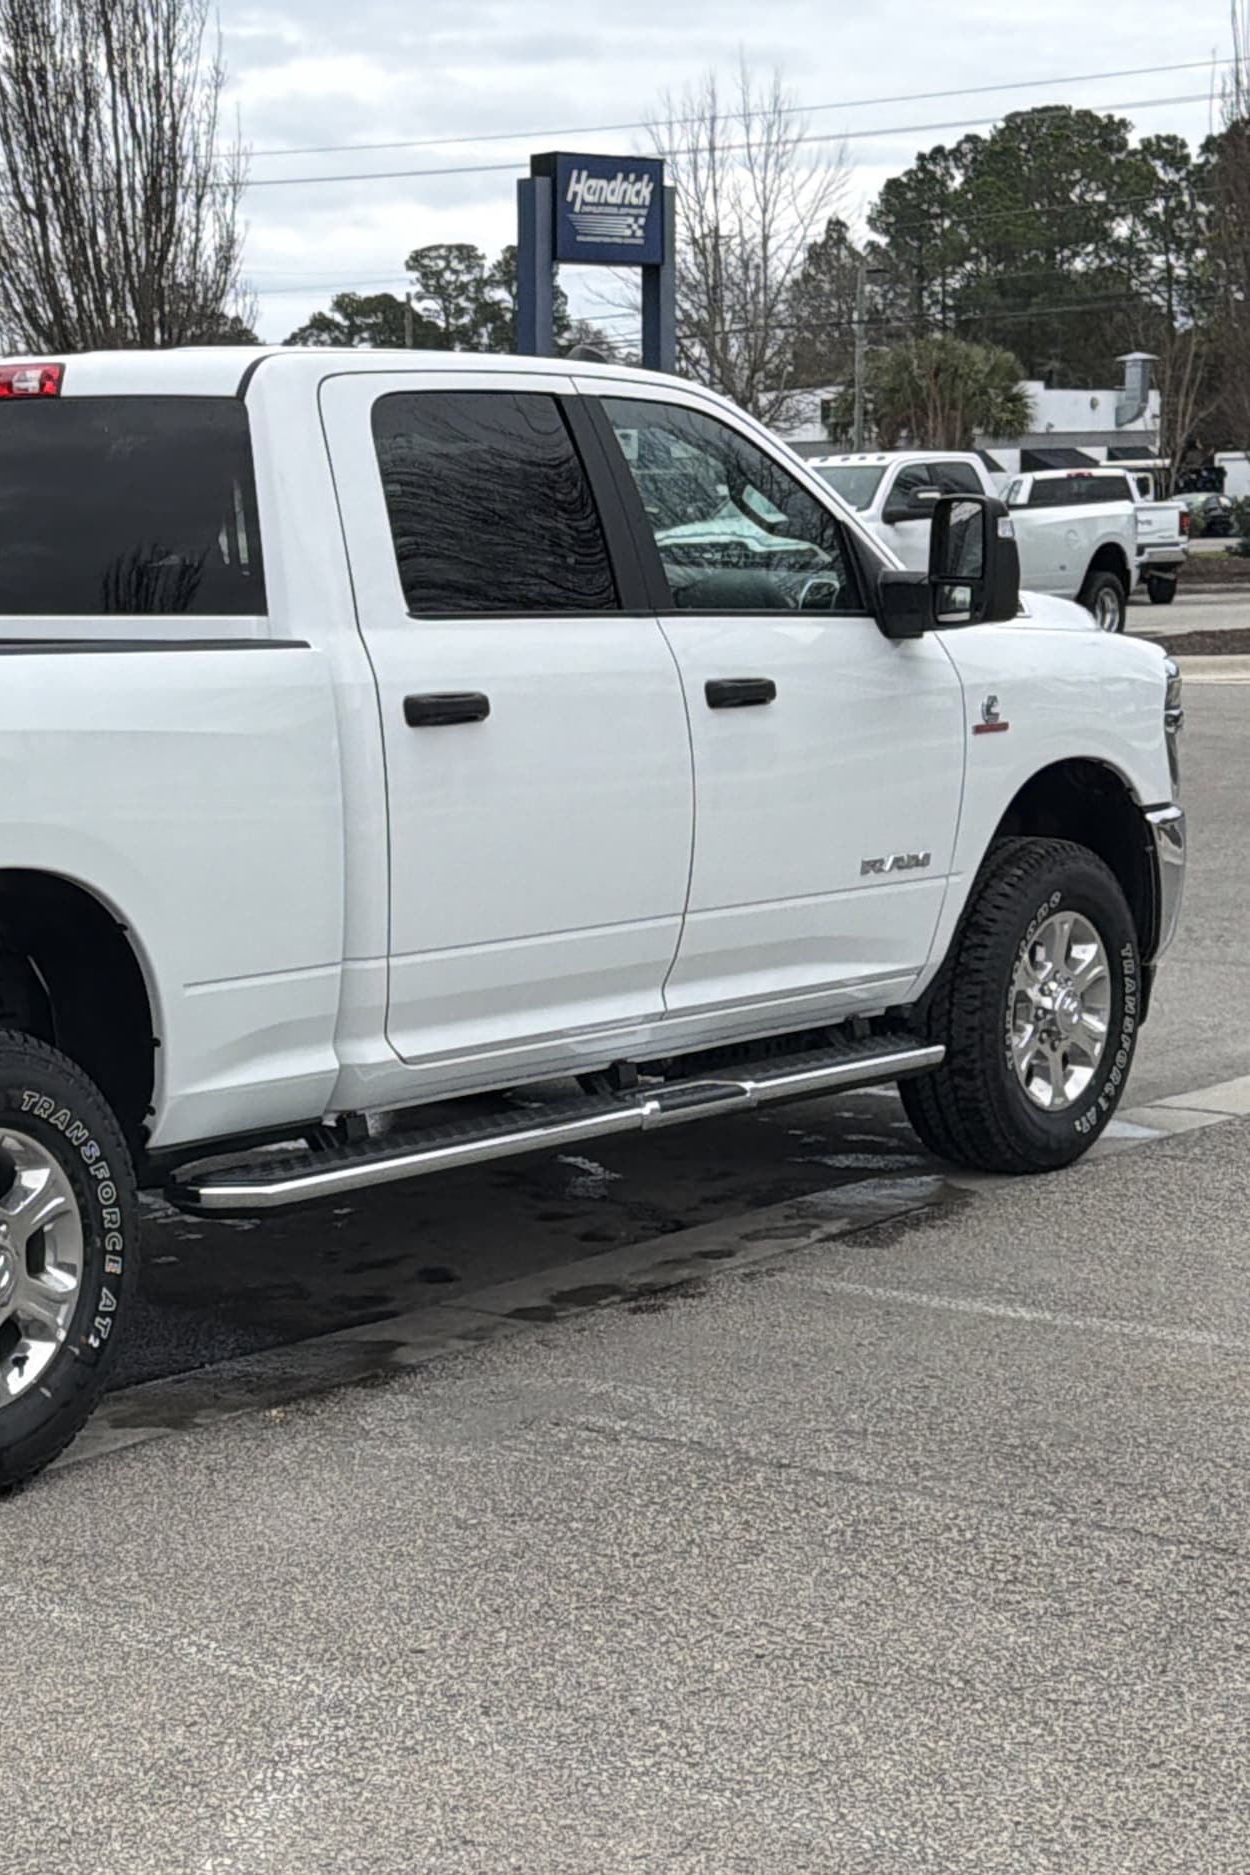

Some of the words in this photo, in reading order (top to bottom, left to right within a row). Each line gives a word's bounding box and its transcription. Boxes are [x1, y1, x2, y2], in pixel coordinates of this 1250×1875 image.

[566, 169, 654, 213] Hendrick
[860, 852, 931, 876] RAM
[21, 1090, 123, 1275] TRANSFORCE
